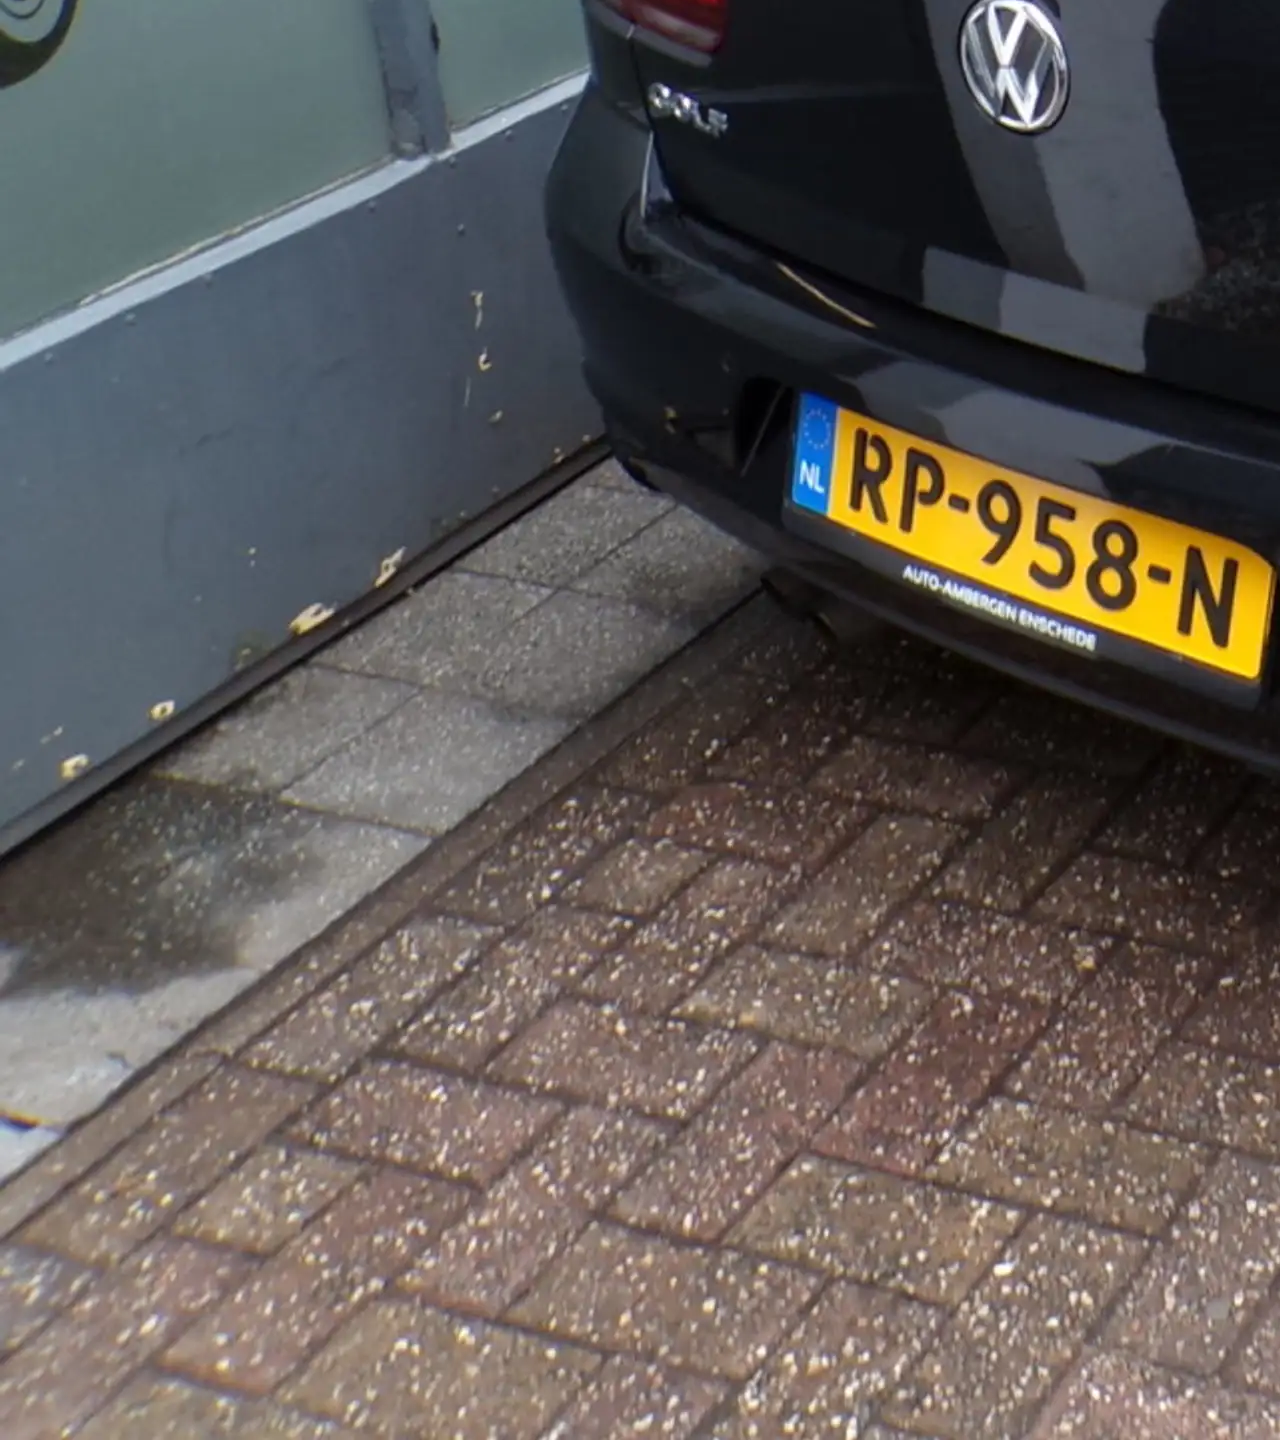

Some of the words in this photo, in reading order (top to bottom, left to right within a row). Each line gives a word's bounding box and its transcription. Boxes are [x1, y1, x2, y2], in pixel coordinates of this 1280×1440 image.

[799, 460, 825, 494] NL
[849, 427, 1240, 649] RP-958-N
[1018, 608, 1098, 651] ENSCHEDE
